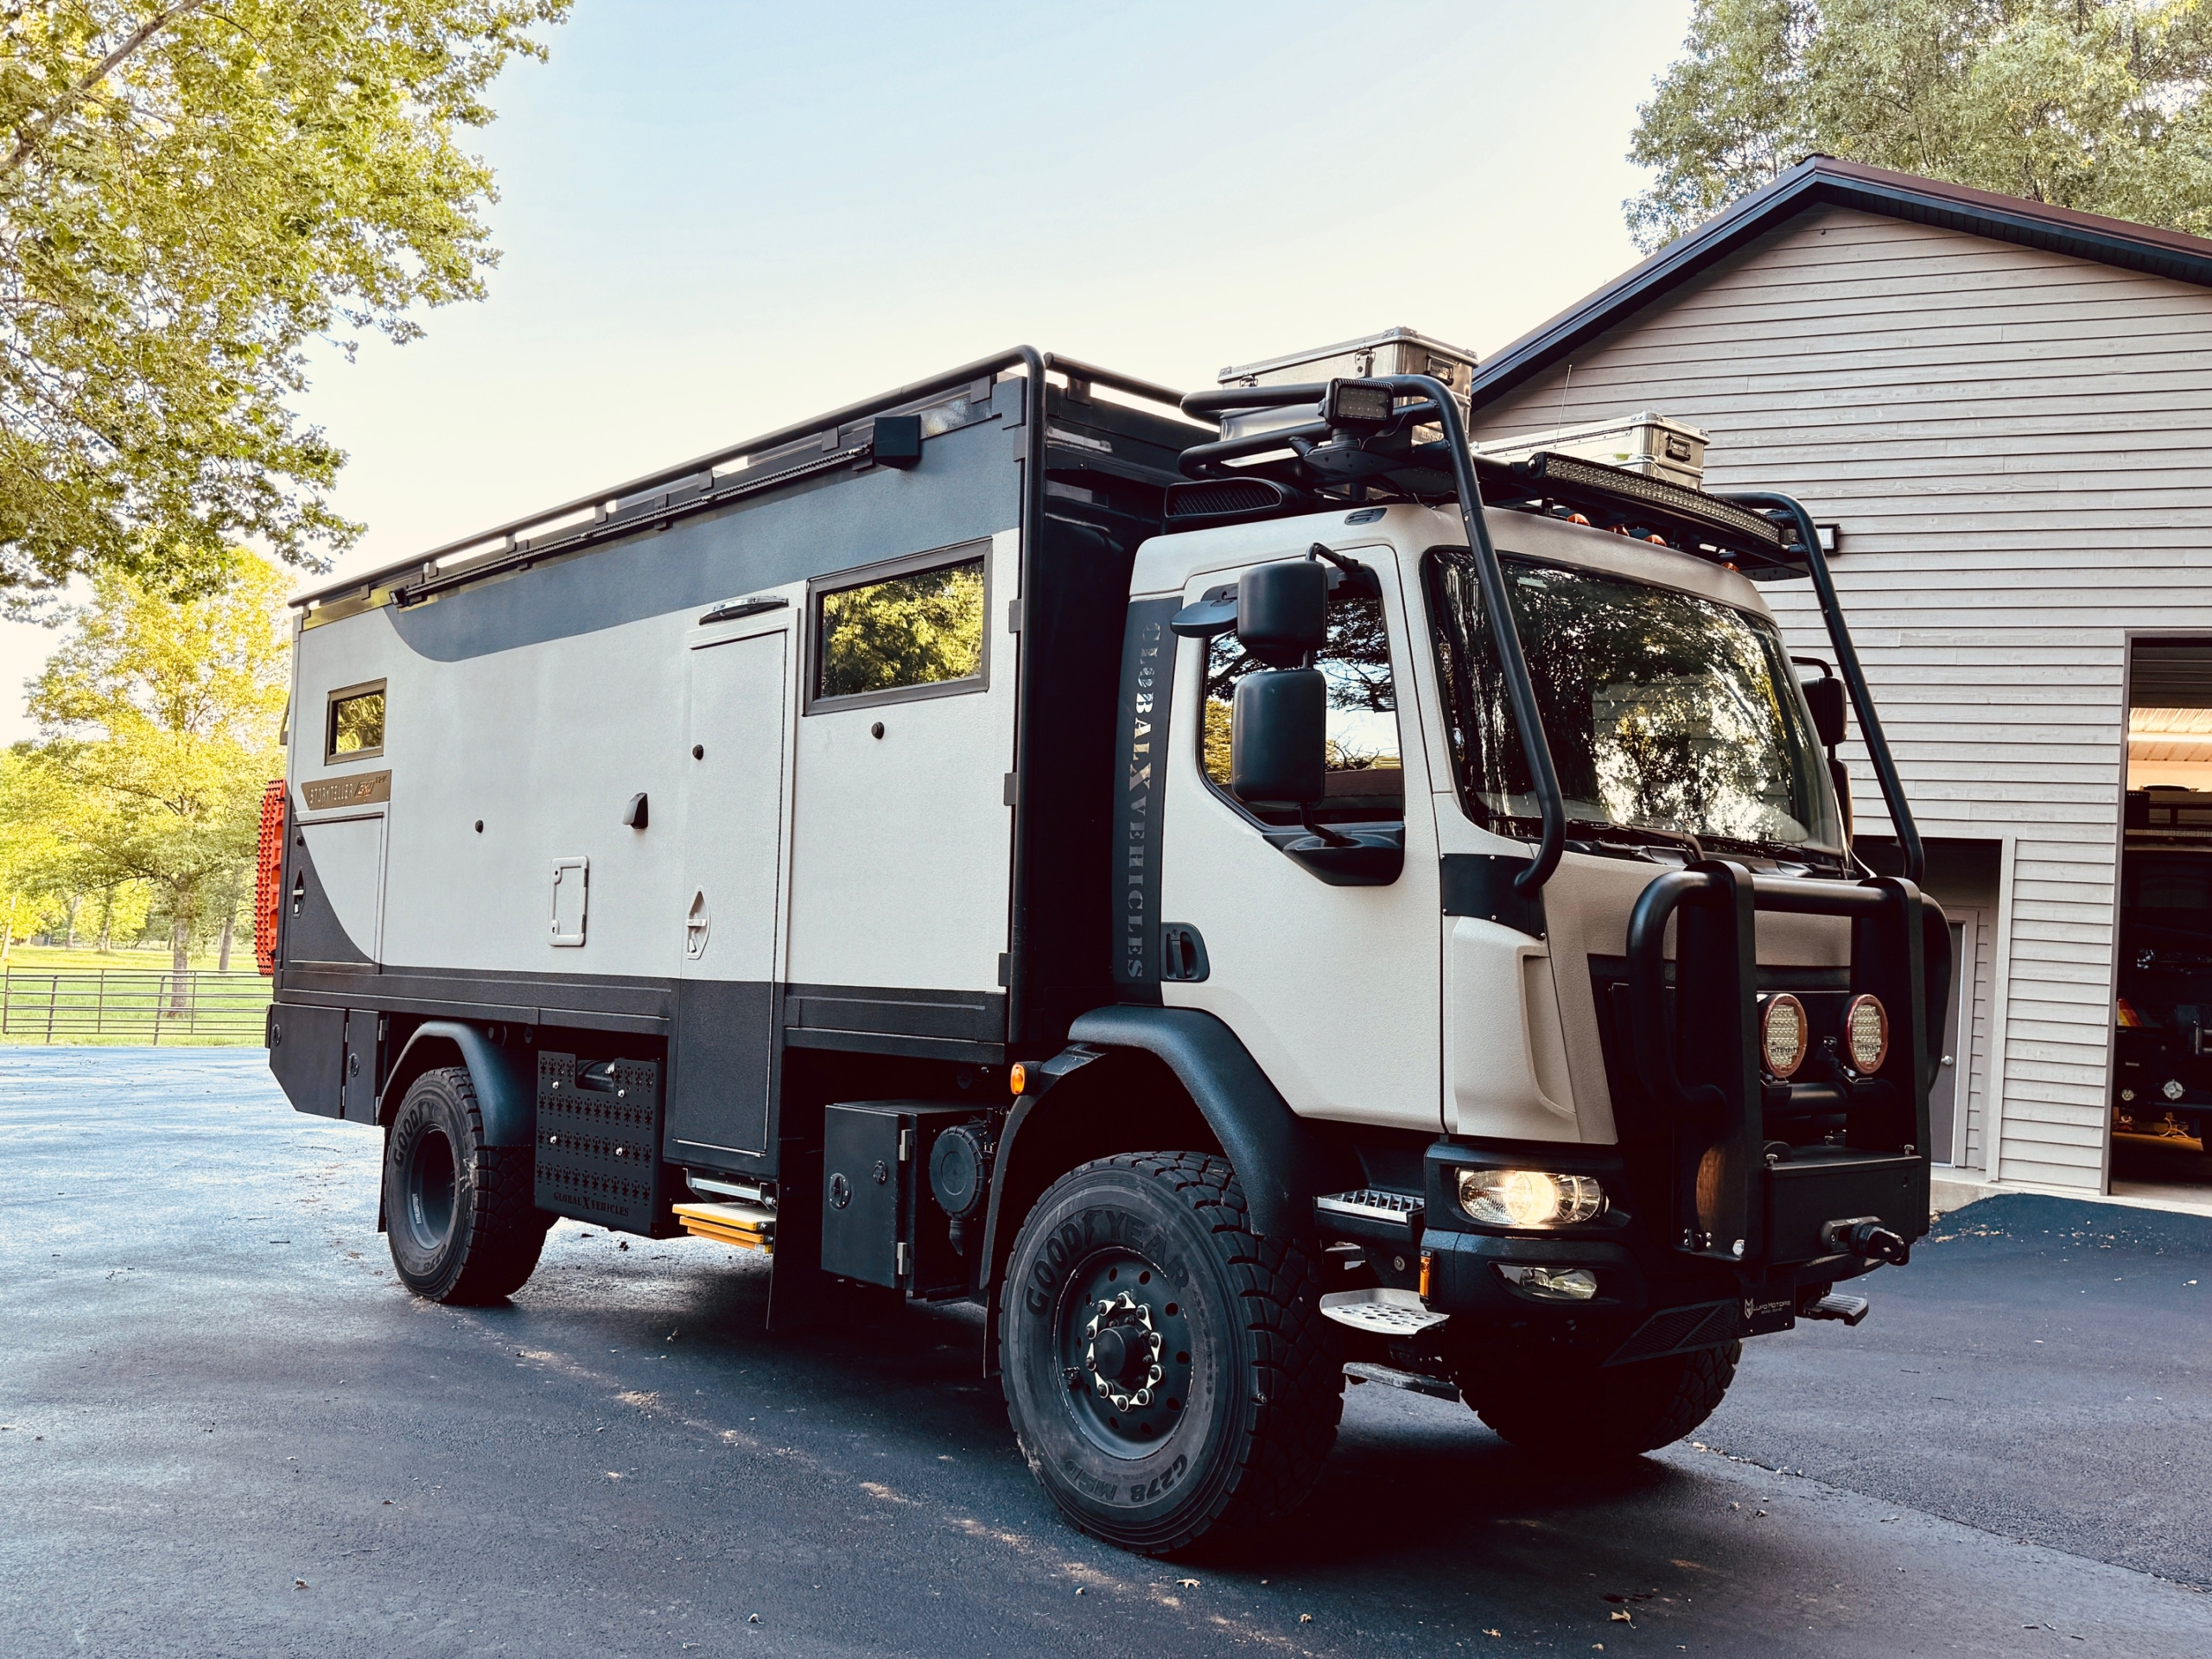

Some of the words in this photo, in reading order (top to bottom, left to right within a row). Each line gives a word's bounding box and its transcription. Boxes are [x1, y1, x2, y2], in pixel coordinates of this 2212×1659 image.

[1128, 763, 1152, 792] X
[1128, 795, 1147, 978] VEHICLES
[553, 1192, 582, 1206] GLOBAL
[582, 1196, 590, 1210] X
[591, 1199, 630, 1217] VEHICLES
[1026, 1209, 1190, 1318] GOODYEAR
[1130, 1453, 1188, 1503] G278
